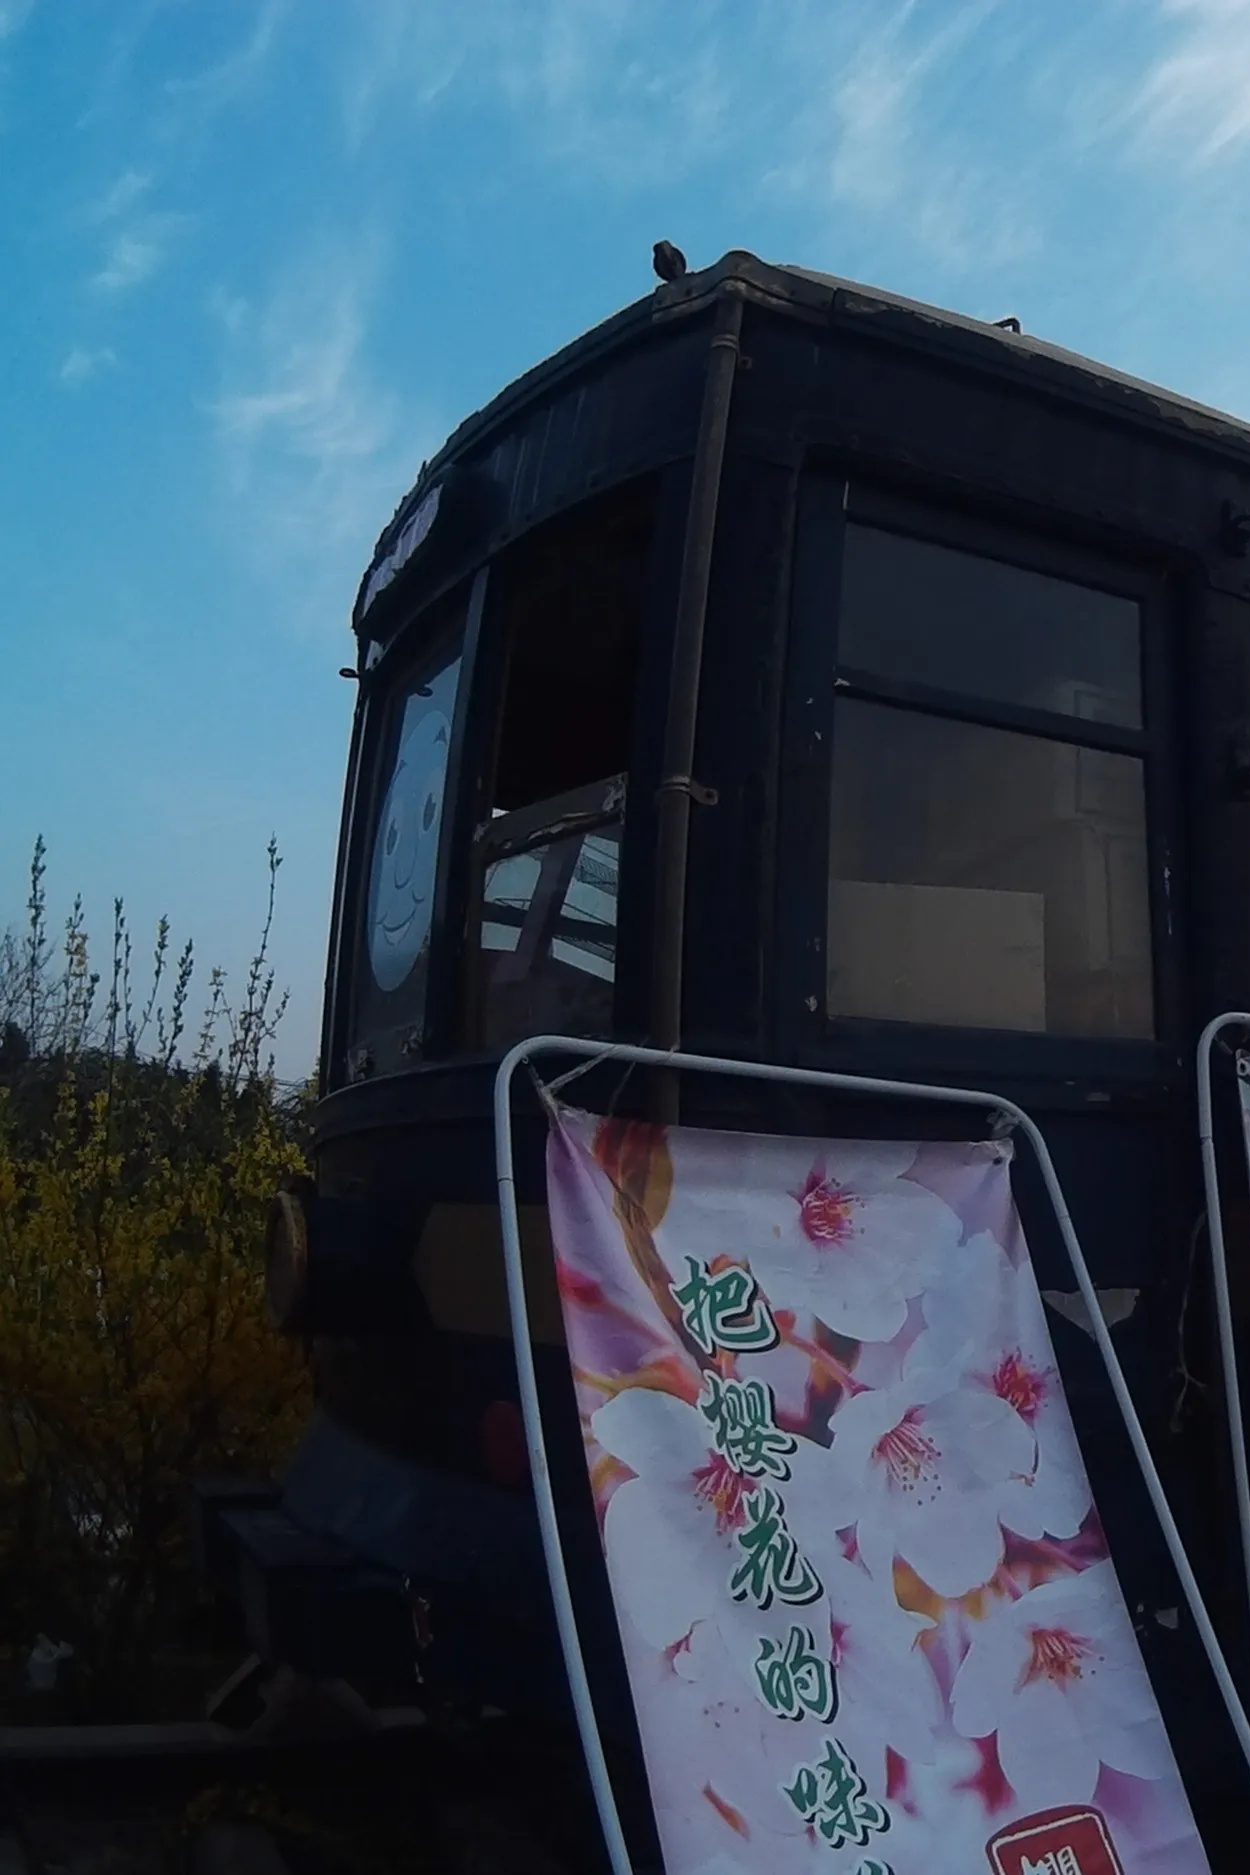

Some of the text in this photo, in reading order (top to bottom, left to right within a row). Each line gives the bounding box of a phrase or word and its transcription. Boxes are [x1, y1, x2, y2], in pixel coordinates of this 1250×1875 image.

[674, 1257, 890, 1875] 把樱花的味
